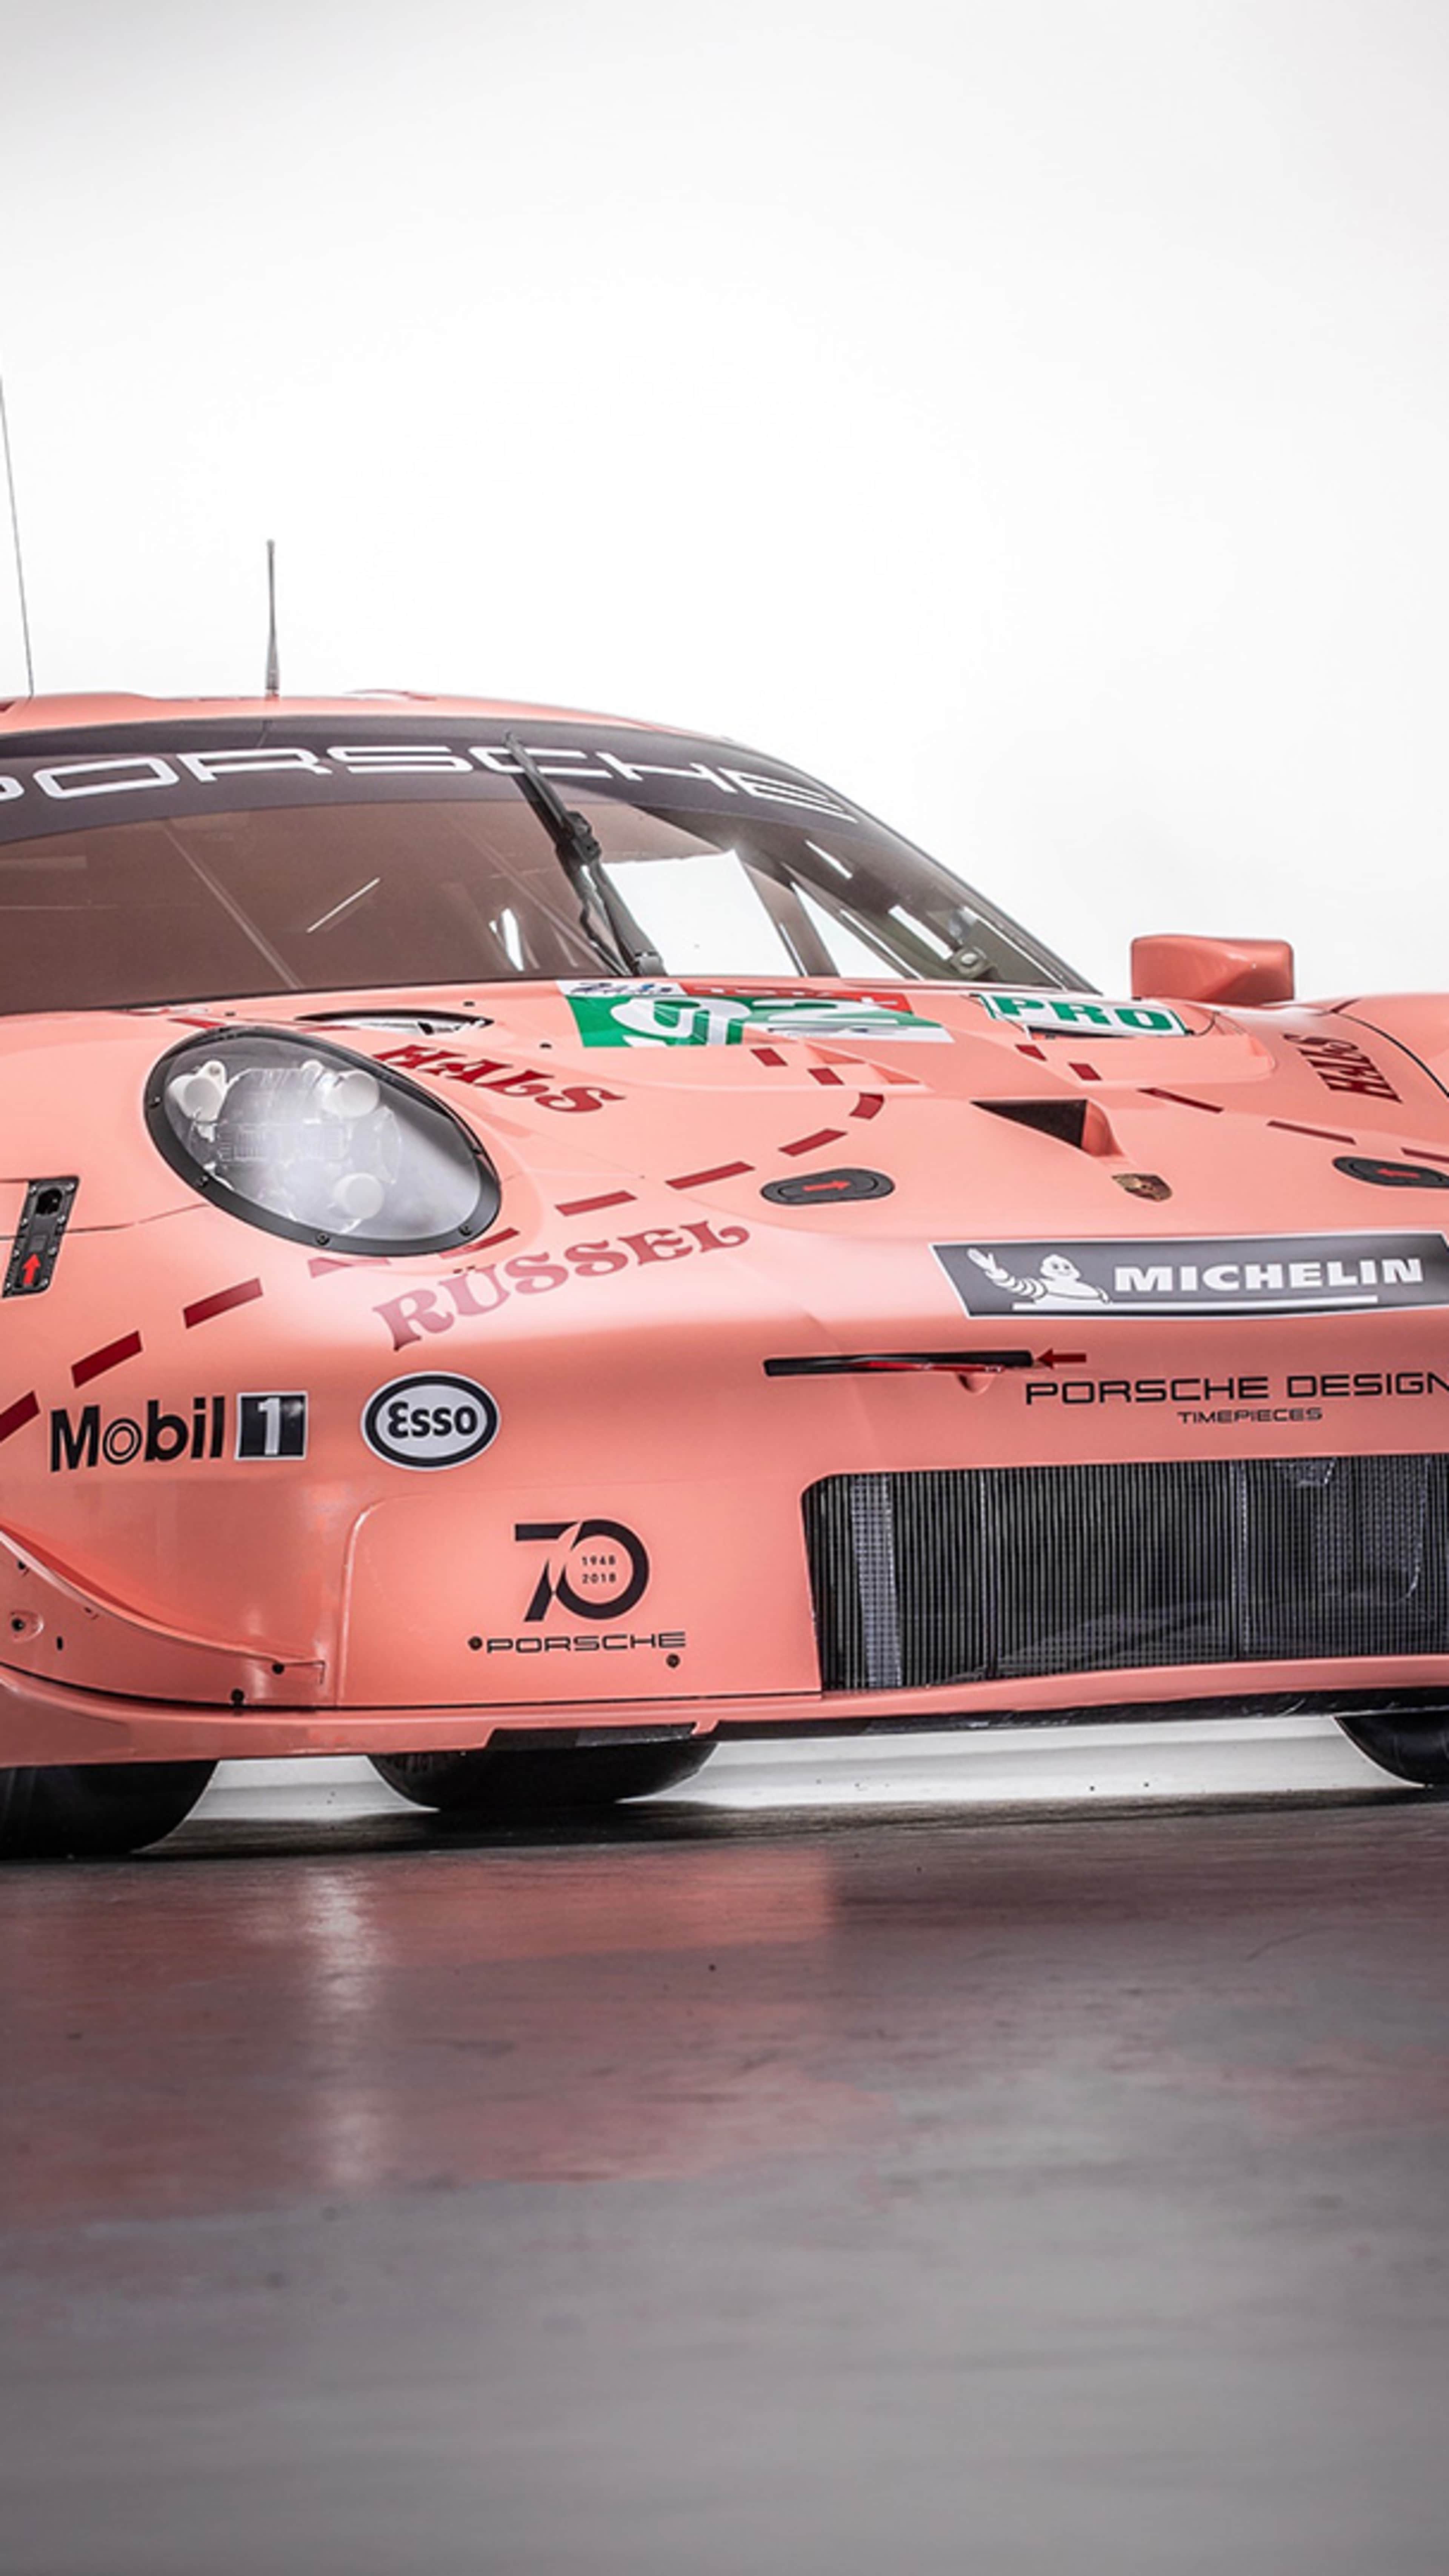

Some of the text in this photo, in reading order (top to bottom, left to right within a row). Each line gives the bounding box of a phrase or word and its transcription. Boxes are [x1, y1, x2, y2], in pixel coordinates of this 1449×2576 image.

[0, 746, 858, 824] ORSCHE
[610, 998, 898, 1047] 92
[992, 995, 1173, 1030] PRO
[372, 1044, 627, 1113] HALS
[1281, 1032, 1403, 1103] HALS
[373, 1221, 750, 1352] RÜSSEL
[1114, 1258, 1423, 1292] MICHELIN
[1026, 1372, 1449, 1405] PORSCHE DESIGN
[388, 1401, 478, 1438] Esso
[1177, 1406, 1323, 1424] TIMEPIECES
[50, 1395, 282, 1473] Mobil 1
[515, 1519, 649, 1622] 70
[581, 1555, 616, 1566] 1948
[582, 1572, 617, 1584] 2018
[486, 1631, 686, 1654] PORSCHE
